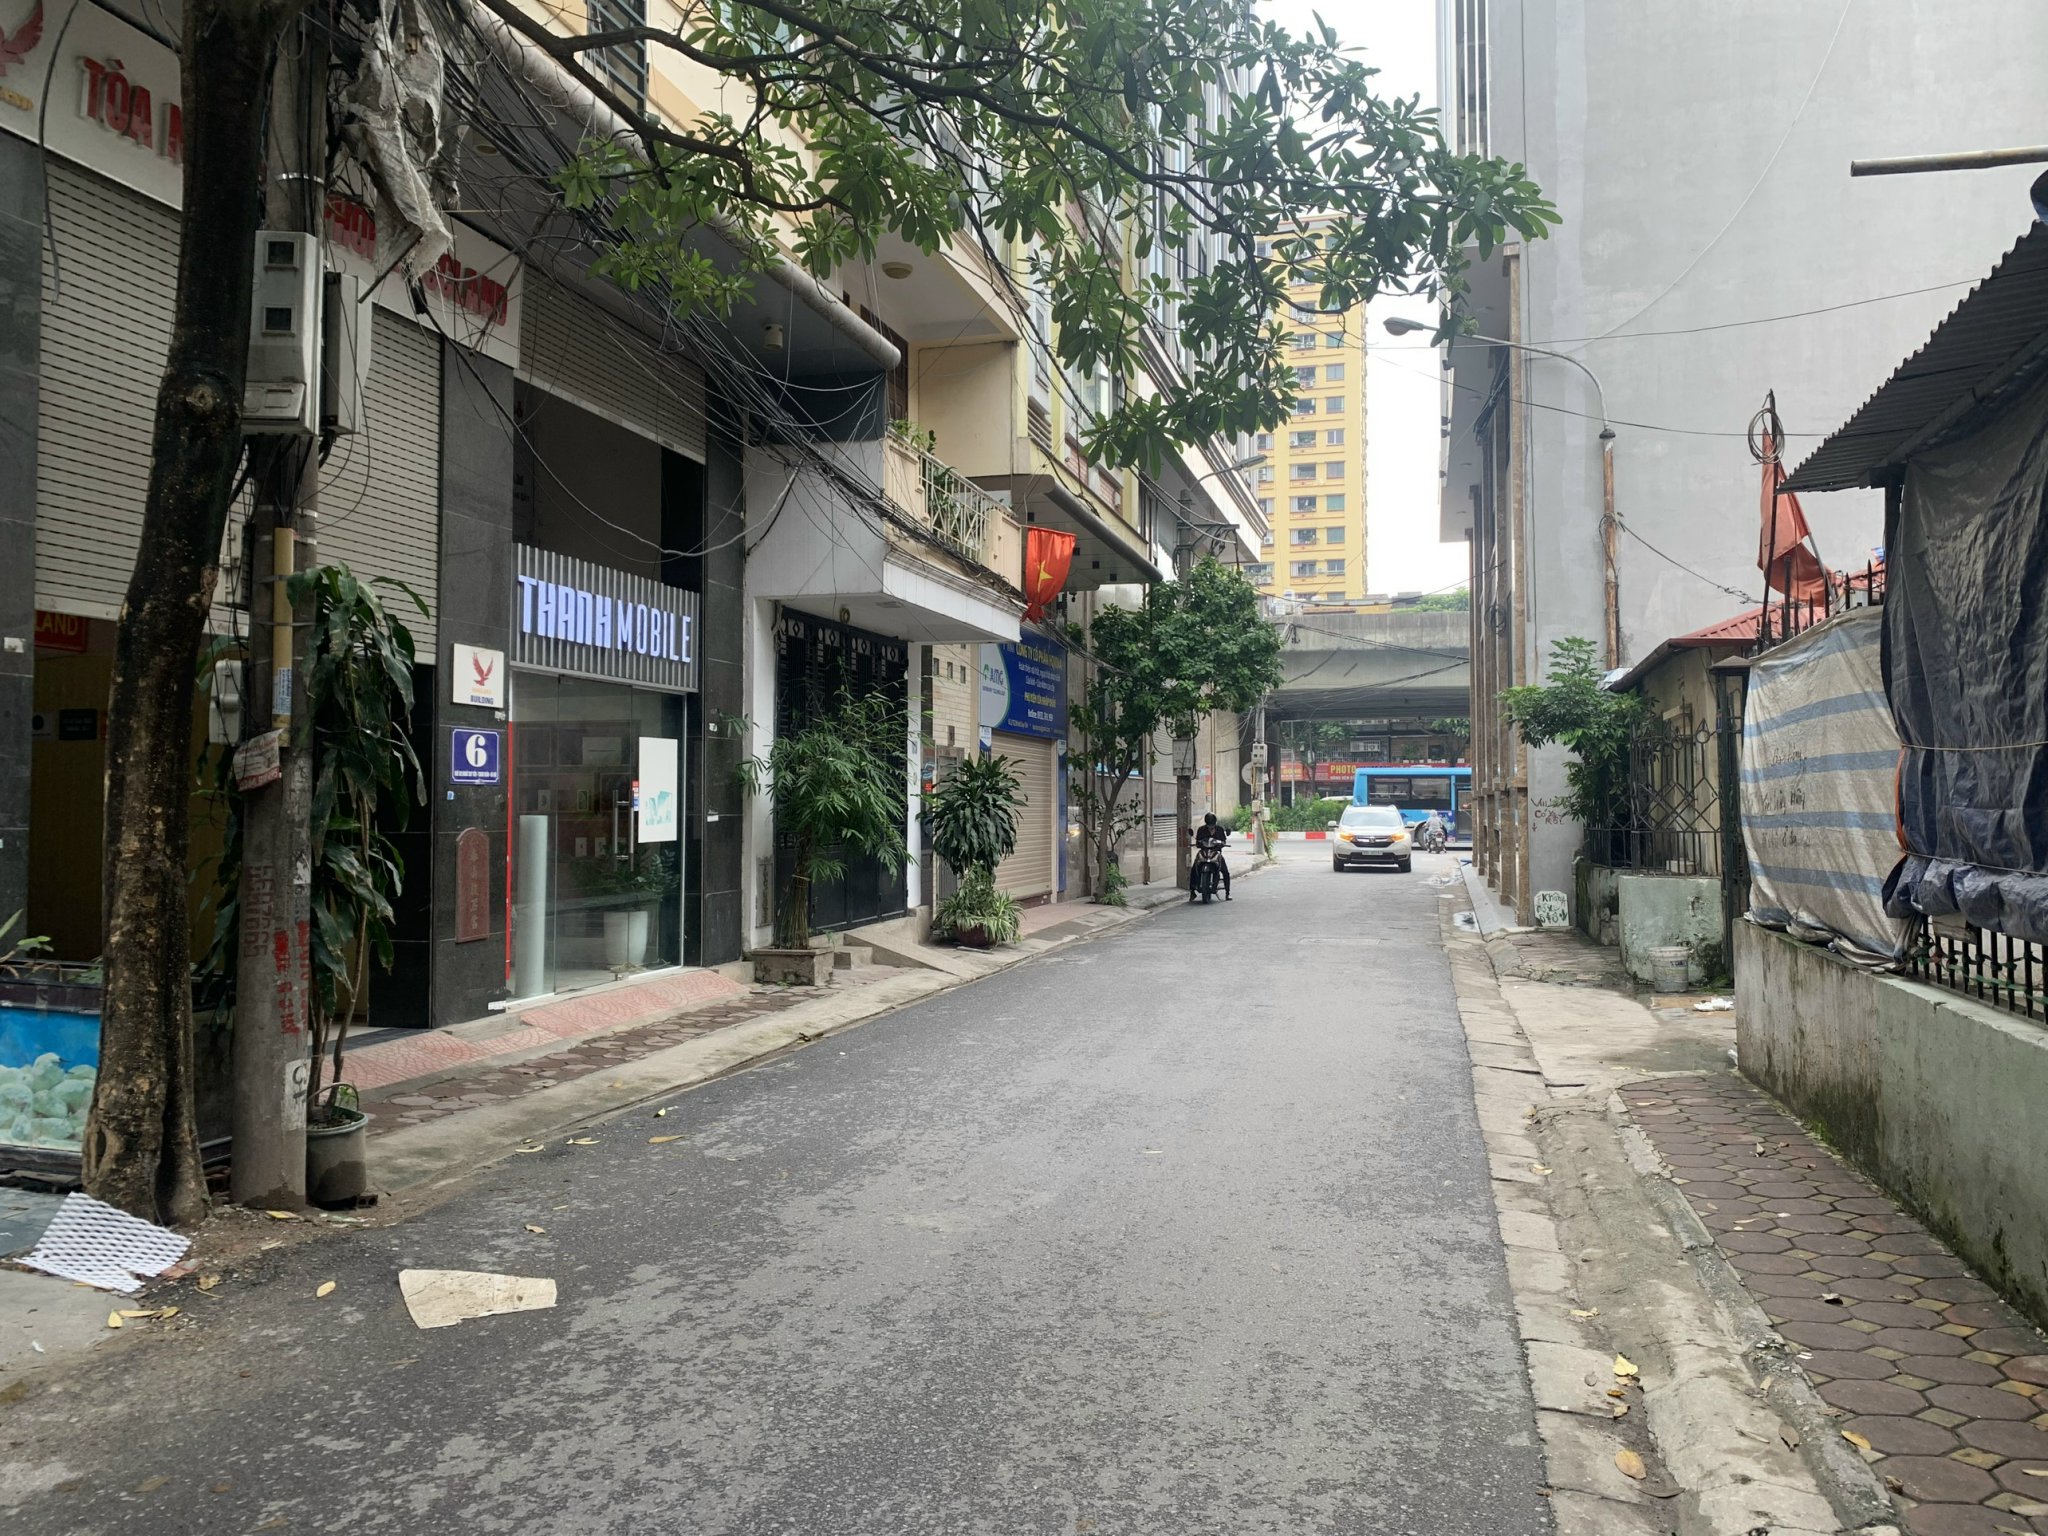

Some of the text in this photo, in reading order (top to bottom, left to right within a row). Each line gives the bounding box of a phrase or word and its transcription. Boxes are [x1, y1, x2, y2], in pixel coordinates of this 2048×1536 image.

[77, 55, 153, 149] TÒA
[517, 574, 692, 664] THANH MOBILE
[470, 694, 494, 705] BUILDING
[466, 734, 488, 768] 6
[1330, 764, 1357, 775] PHOTO
